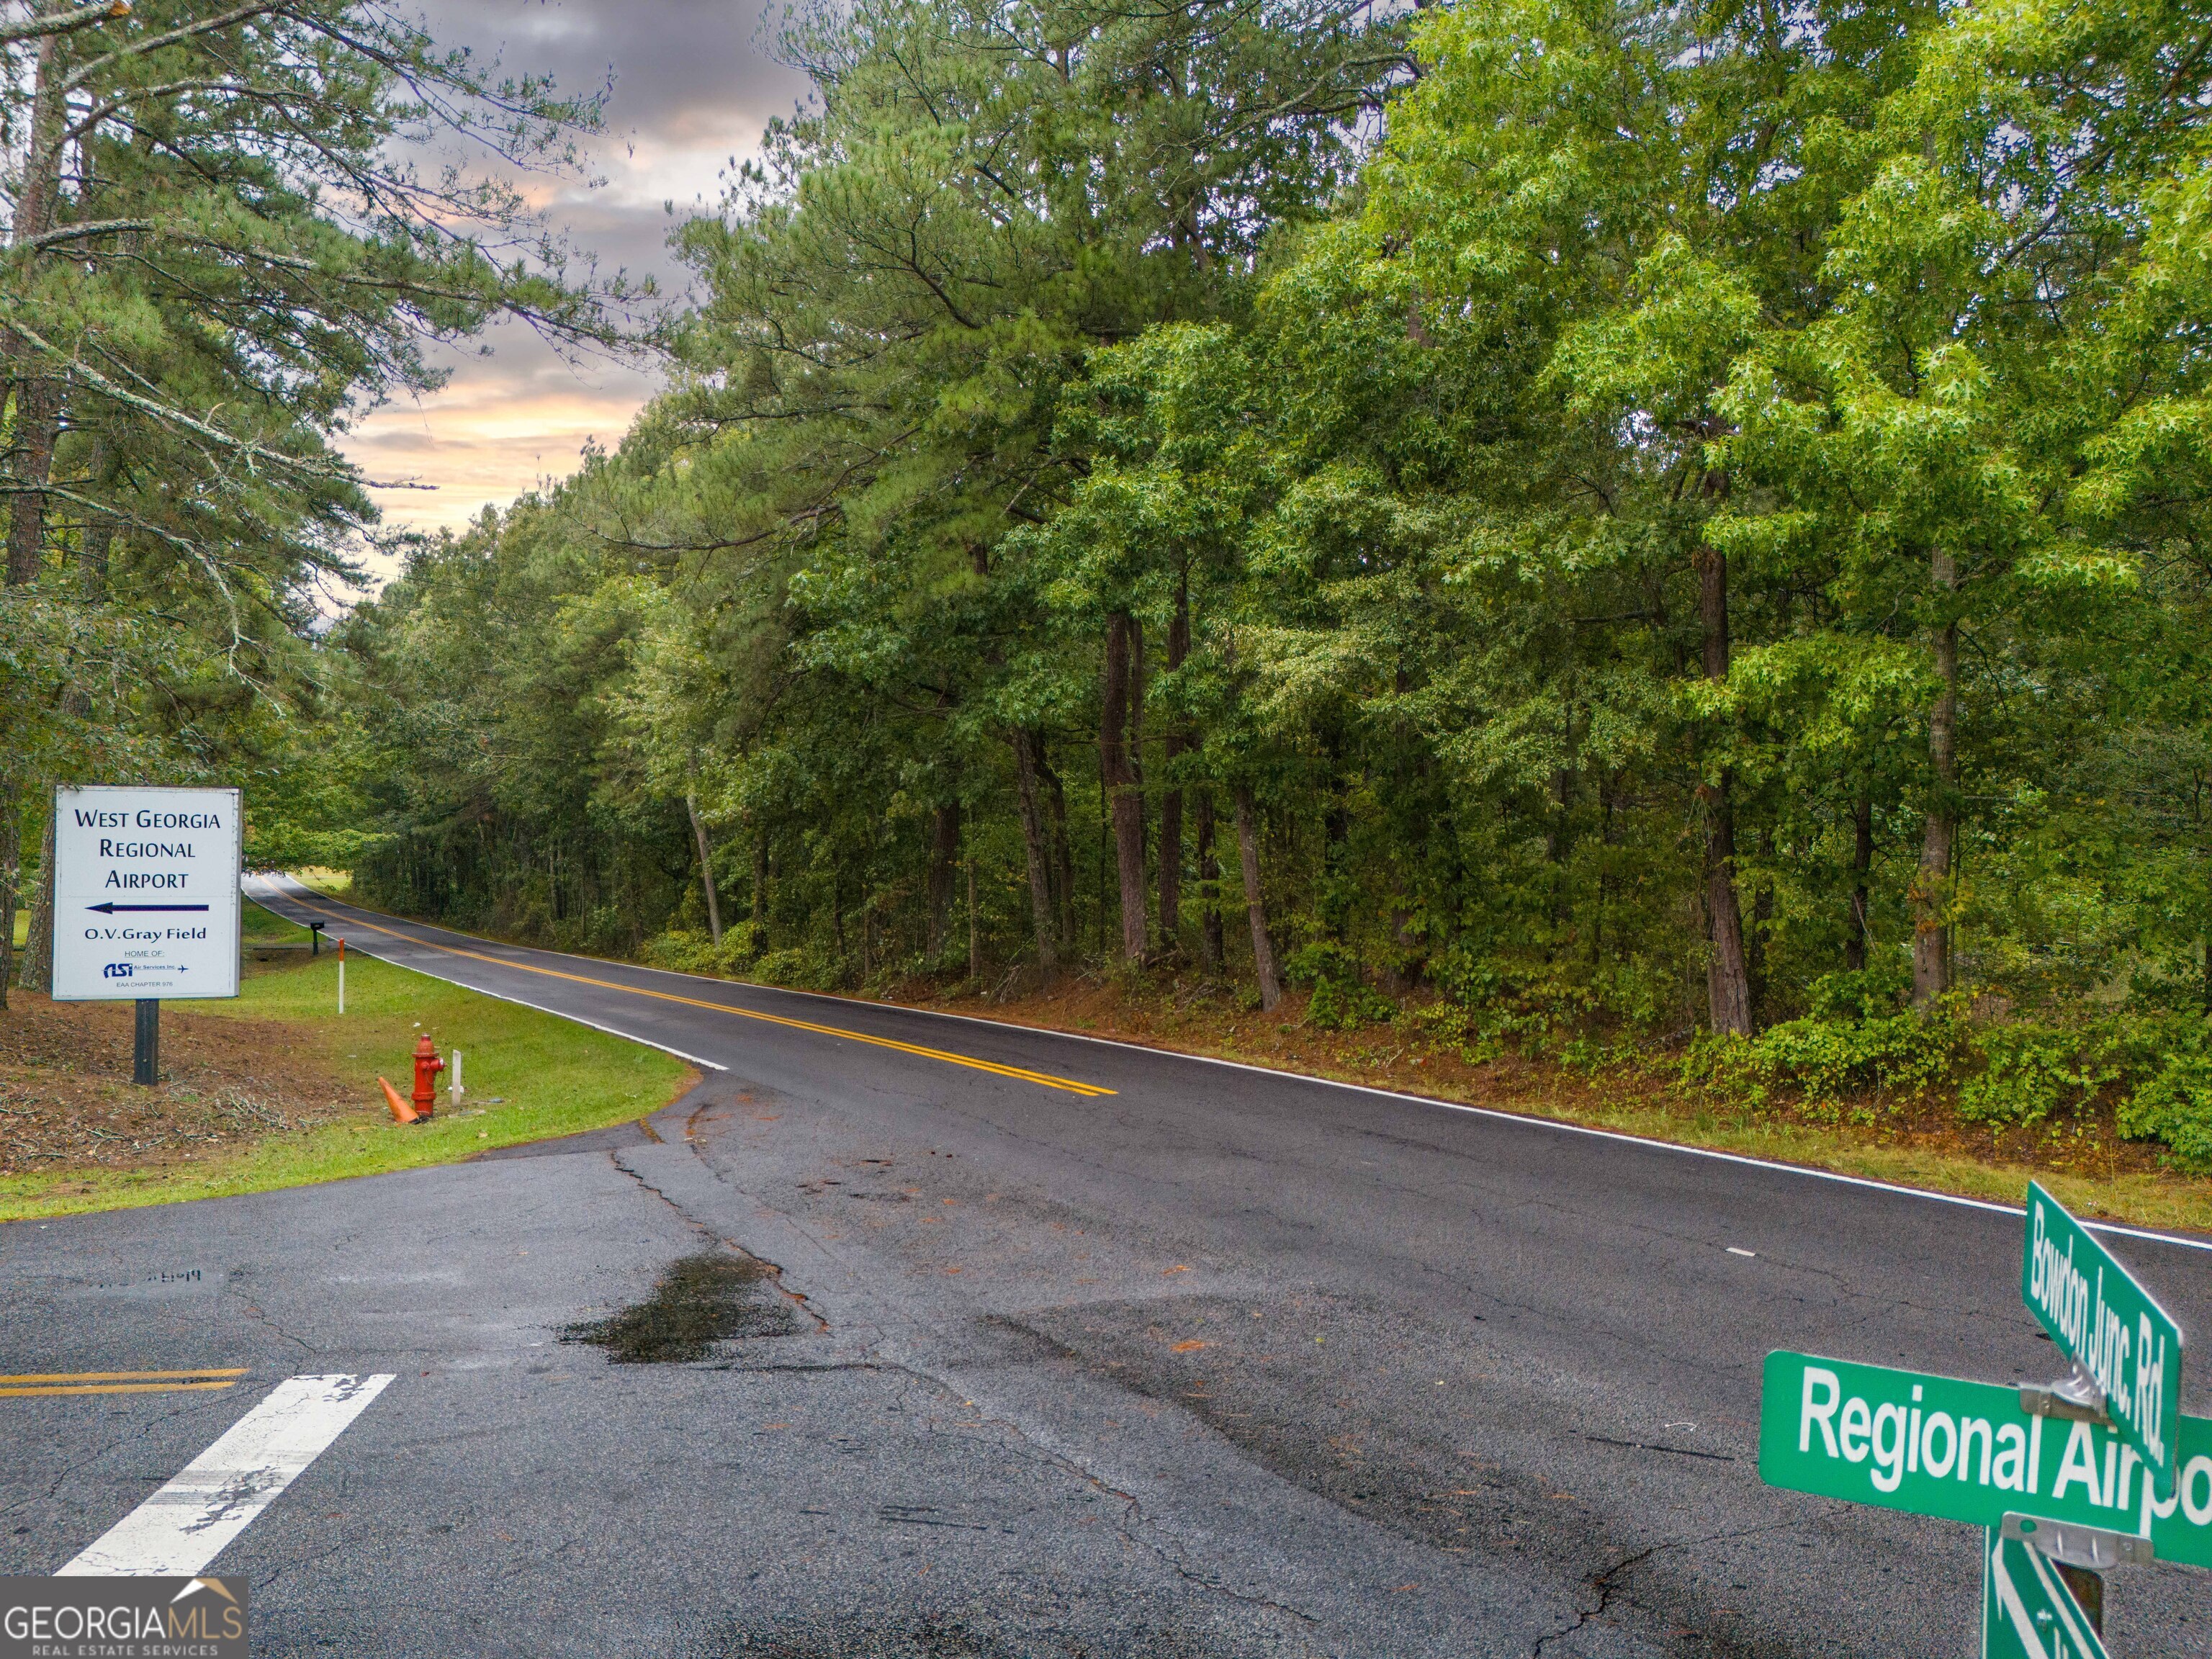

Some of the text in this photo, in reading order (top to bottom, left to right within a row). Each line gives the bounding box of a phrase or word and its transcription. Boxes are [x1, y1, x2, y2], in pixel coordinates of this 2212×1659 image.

[75, 809, 221, 829] WEST GEORGIA
[99, 839, 196, 858] REGIONAL
[105, 870, 189, 889] AIRPORT
[167, 927, 207, 940] Field
[2030, 1199, 2088, 1357] Bowdon
[2088, 1265, 2131, 1421] Junc.
[1798, 1365, 2041, 1494] Regional
